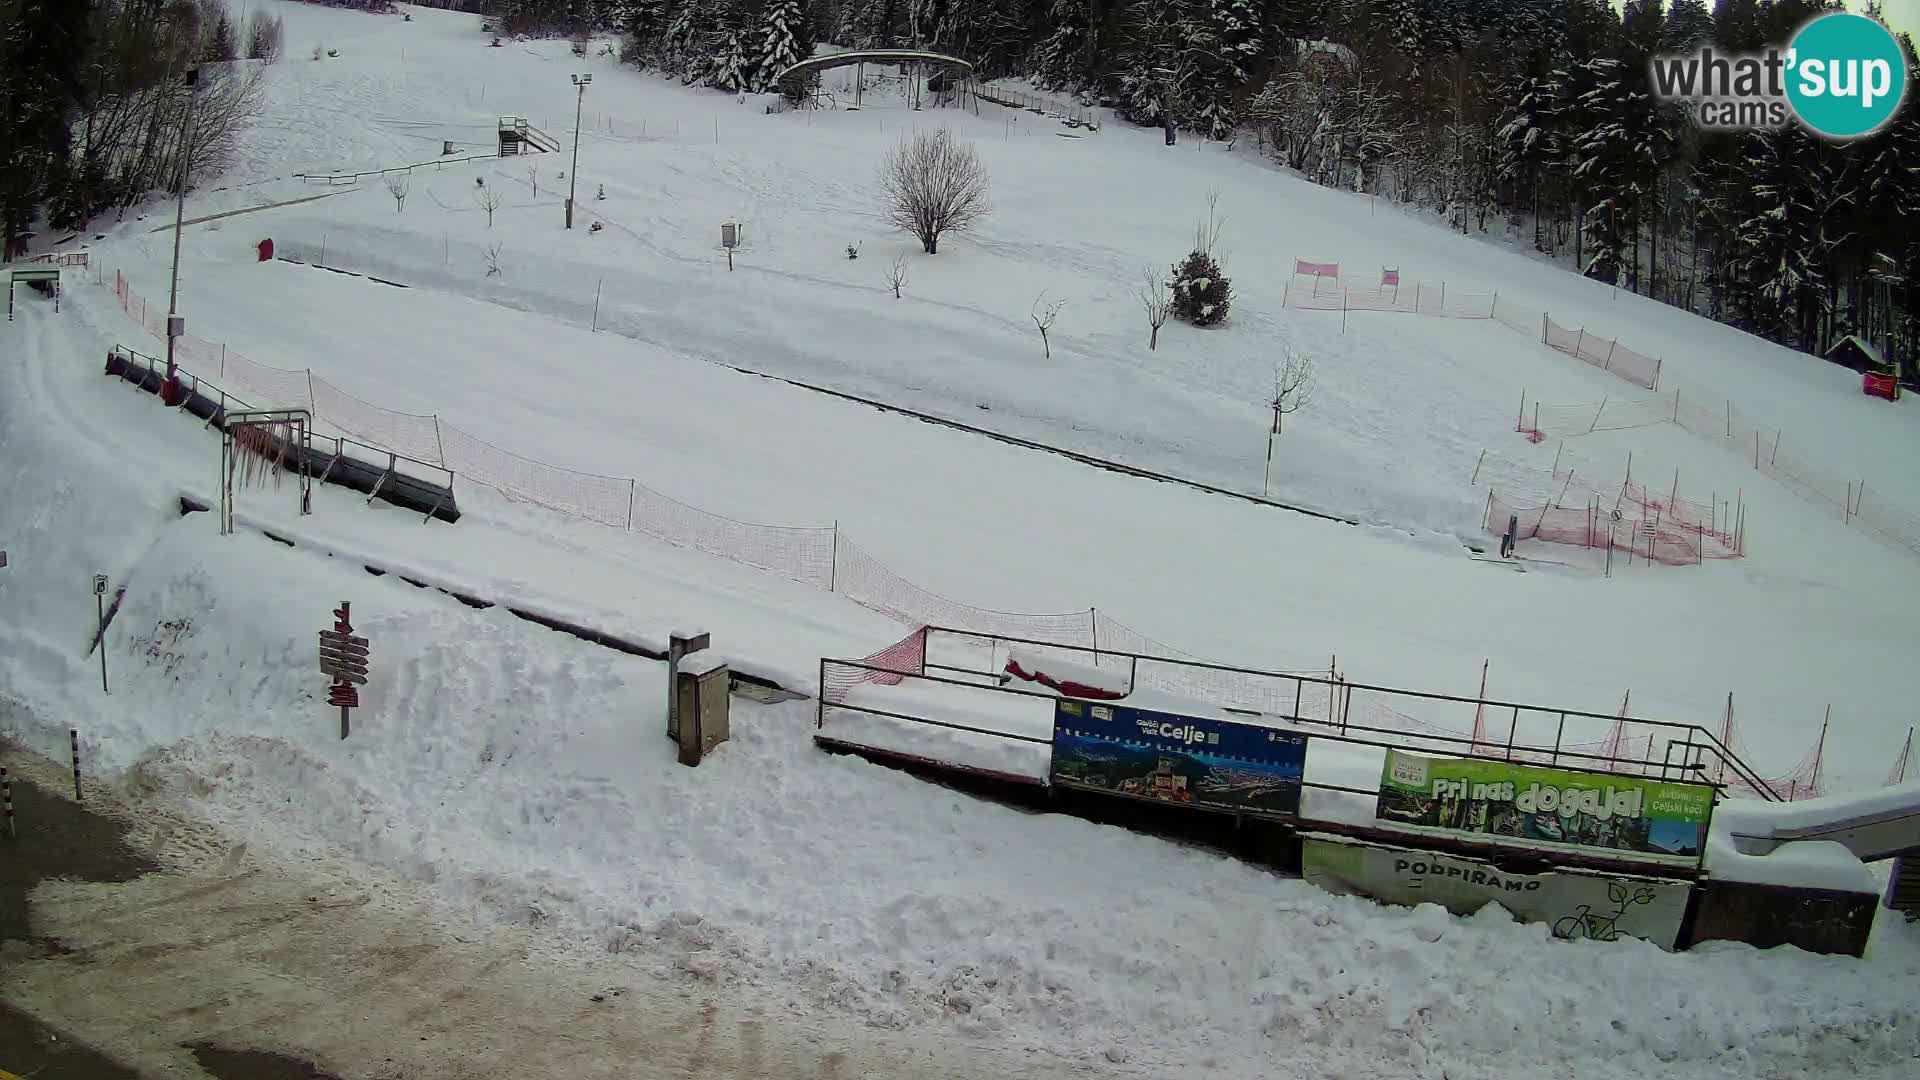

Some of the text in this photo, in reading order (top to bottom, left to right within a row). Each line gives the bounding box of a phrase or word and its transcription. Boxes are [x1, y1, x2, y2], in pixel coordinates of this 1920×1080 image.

[1160, 722, 1205, 744] Celje
[1432, 777, 1643, 821] Pri nas dogaja!
[1395, 859, 1542, 891] PODPIRAMO
